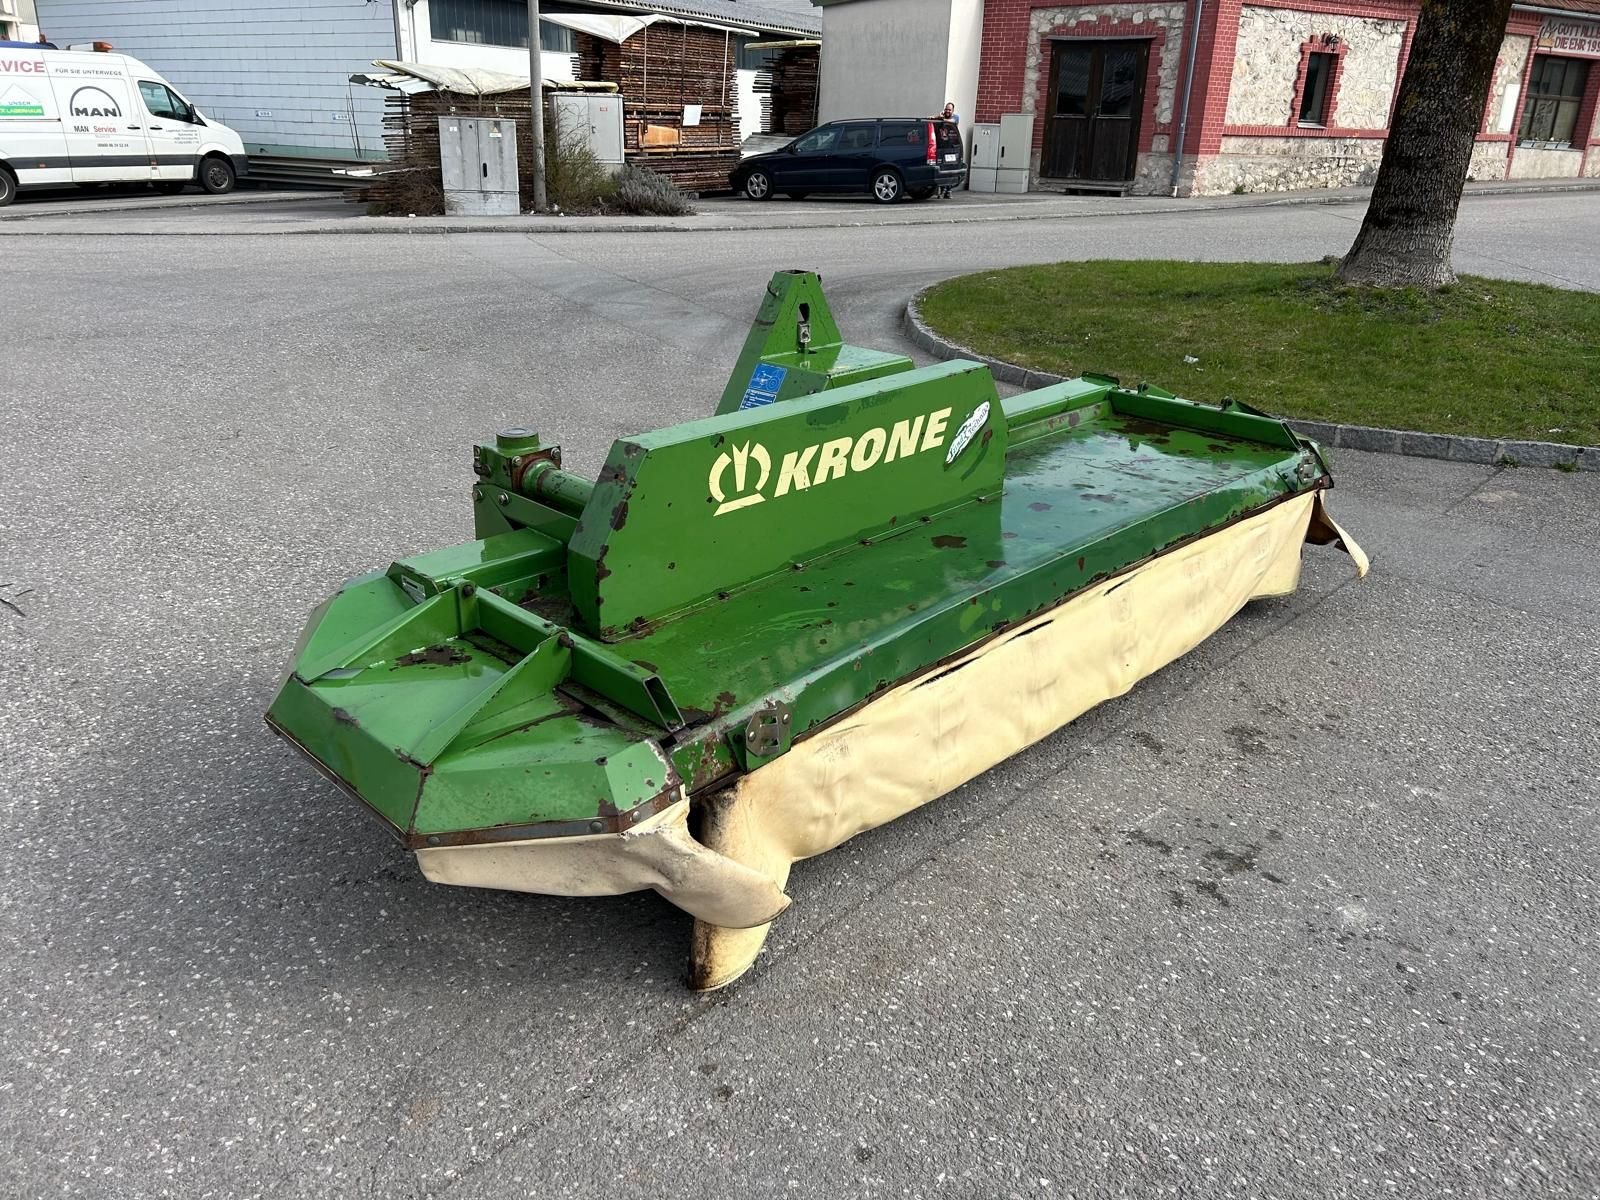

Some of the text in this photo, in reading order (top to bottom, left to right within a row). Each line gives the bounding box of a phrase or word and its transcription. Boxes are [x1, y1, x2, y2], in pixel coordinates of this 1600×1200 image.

[1557, 22, 1581, 37] GOTT
[1554, 37, 1569, 49] DIE
[1569, 38, 1586, 51] EHR
[0, 60, 45, 73] VICE
[74, 107, 118, 117] MAN
[73, 125, 117, 133] MAN Service
[774, 407, 953, 498] KRONE
